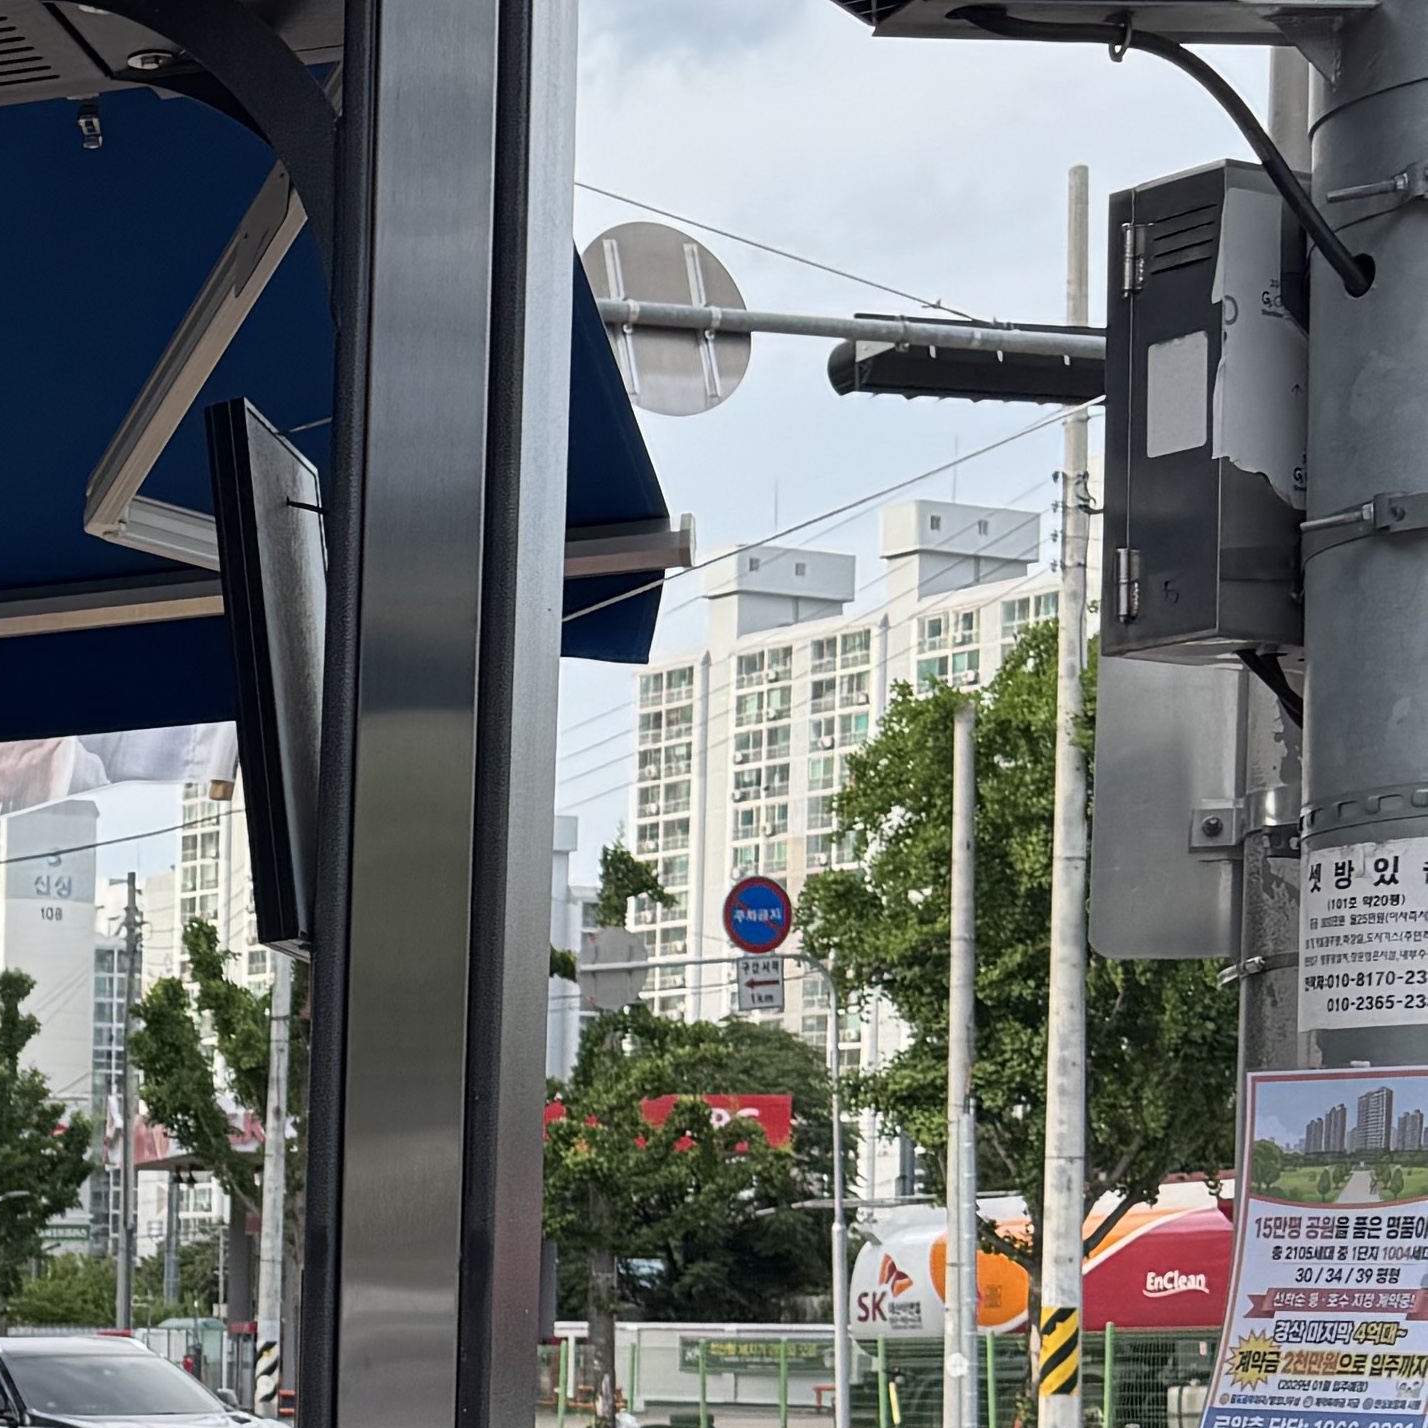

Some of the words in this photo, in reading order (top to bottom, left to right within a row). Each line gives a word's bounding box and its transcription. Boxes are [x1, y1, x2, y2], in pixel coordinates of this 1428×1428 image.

[1327, 994, 1428, 1013] 010-2365-23
[1306, 1216, 1350, 1240] 공원을
[1353, 1216, 1382, 1240] 품은
[1285, 1245, 1335, 1261] 2105세대
[1352, 1245, 1380, 1261] 1단지
[1146, 1270, 1206, 1291] EnClean
[1295, 1267, 1313, 1283] 30
[1325, 1267, 1343, 1283] 34
[1355, 1267, 1374, 1283] 39
[857, 1291, 888, 1322] SK
[1274, 1319, 1306, 1343] 경산
[1305, 1320, 1354, 1344] 마지막
[1235, 1350, 1282, 1374] 계약금
[1281, 1351, 1368, 1376] 2천만원으로
